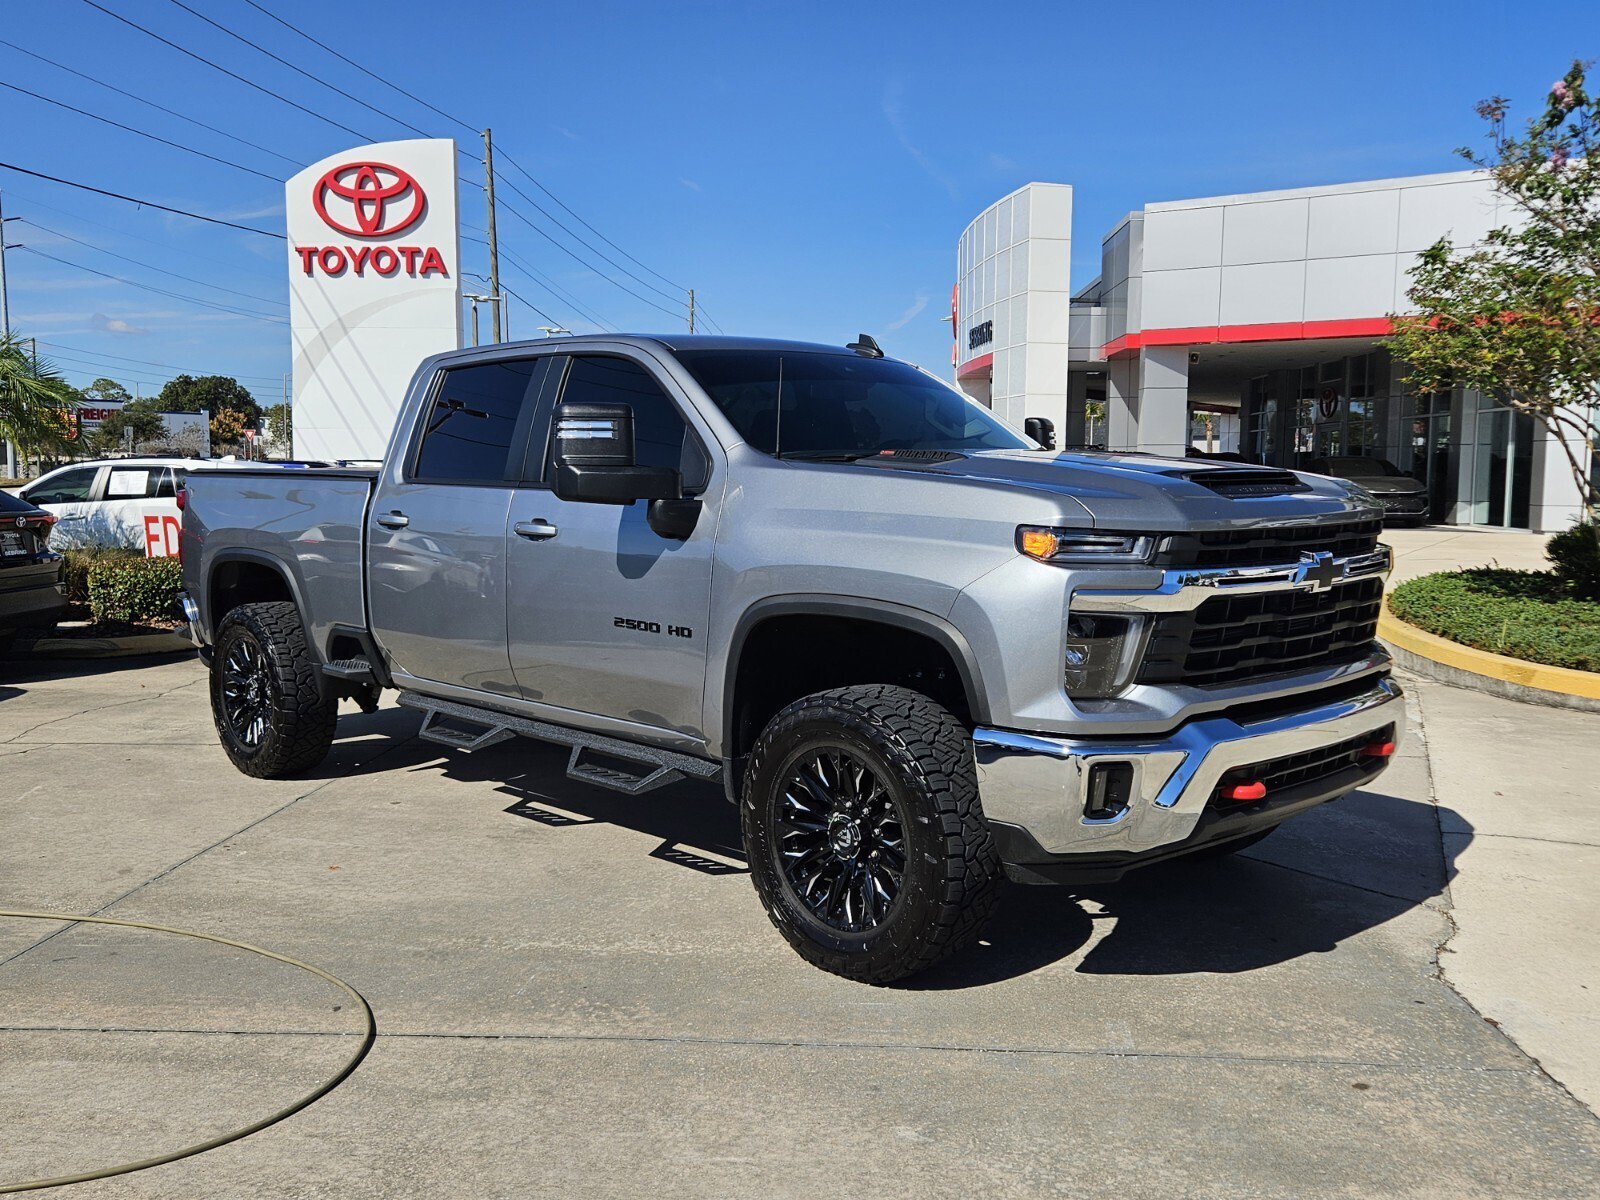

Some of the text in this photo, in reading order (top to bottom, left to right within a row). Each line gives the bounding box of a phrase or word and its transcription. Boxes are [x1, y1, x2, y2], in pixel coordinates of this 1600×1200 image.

[295, 245, 447, 275] TOYOTA
[78, 408, 117, 420] FREIGH
[614, 617, 692, 638] 2500 HD
